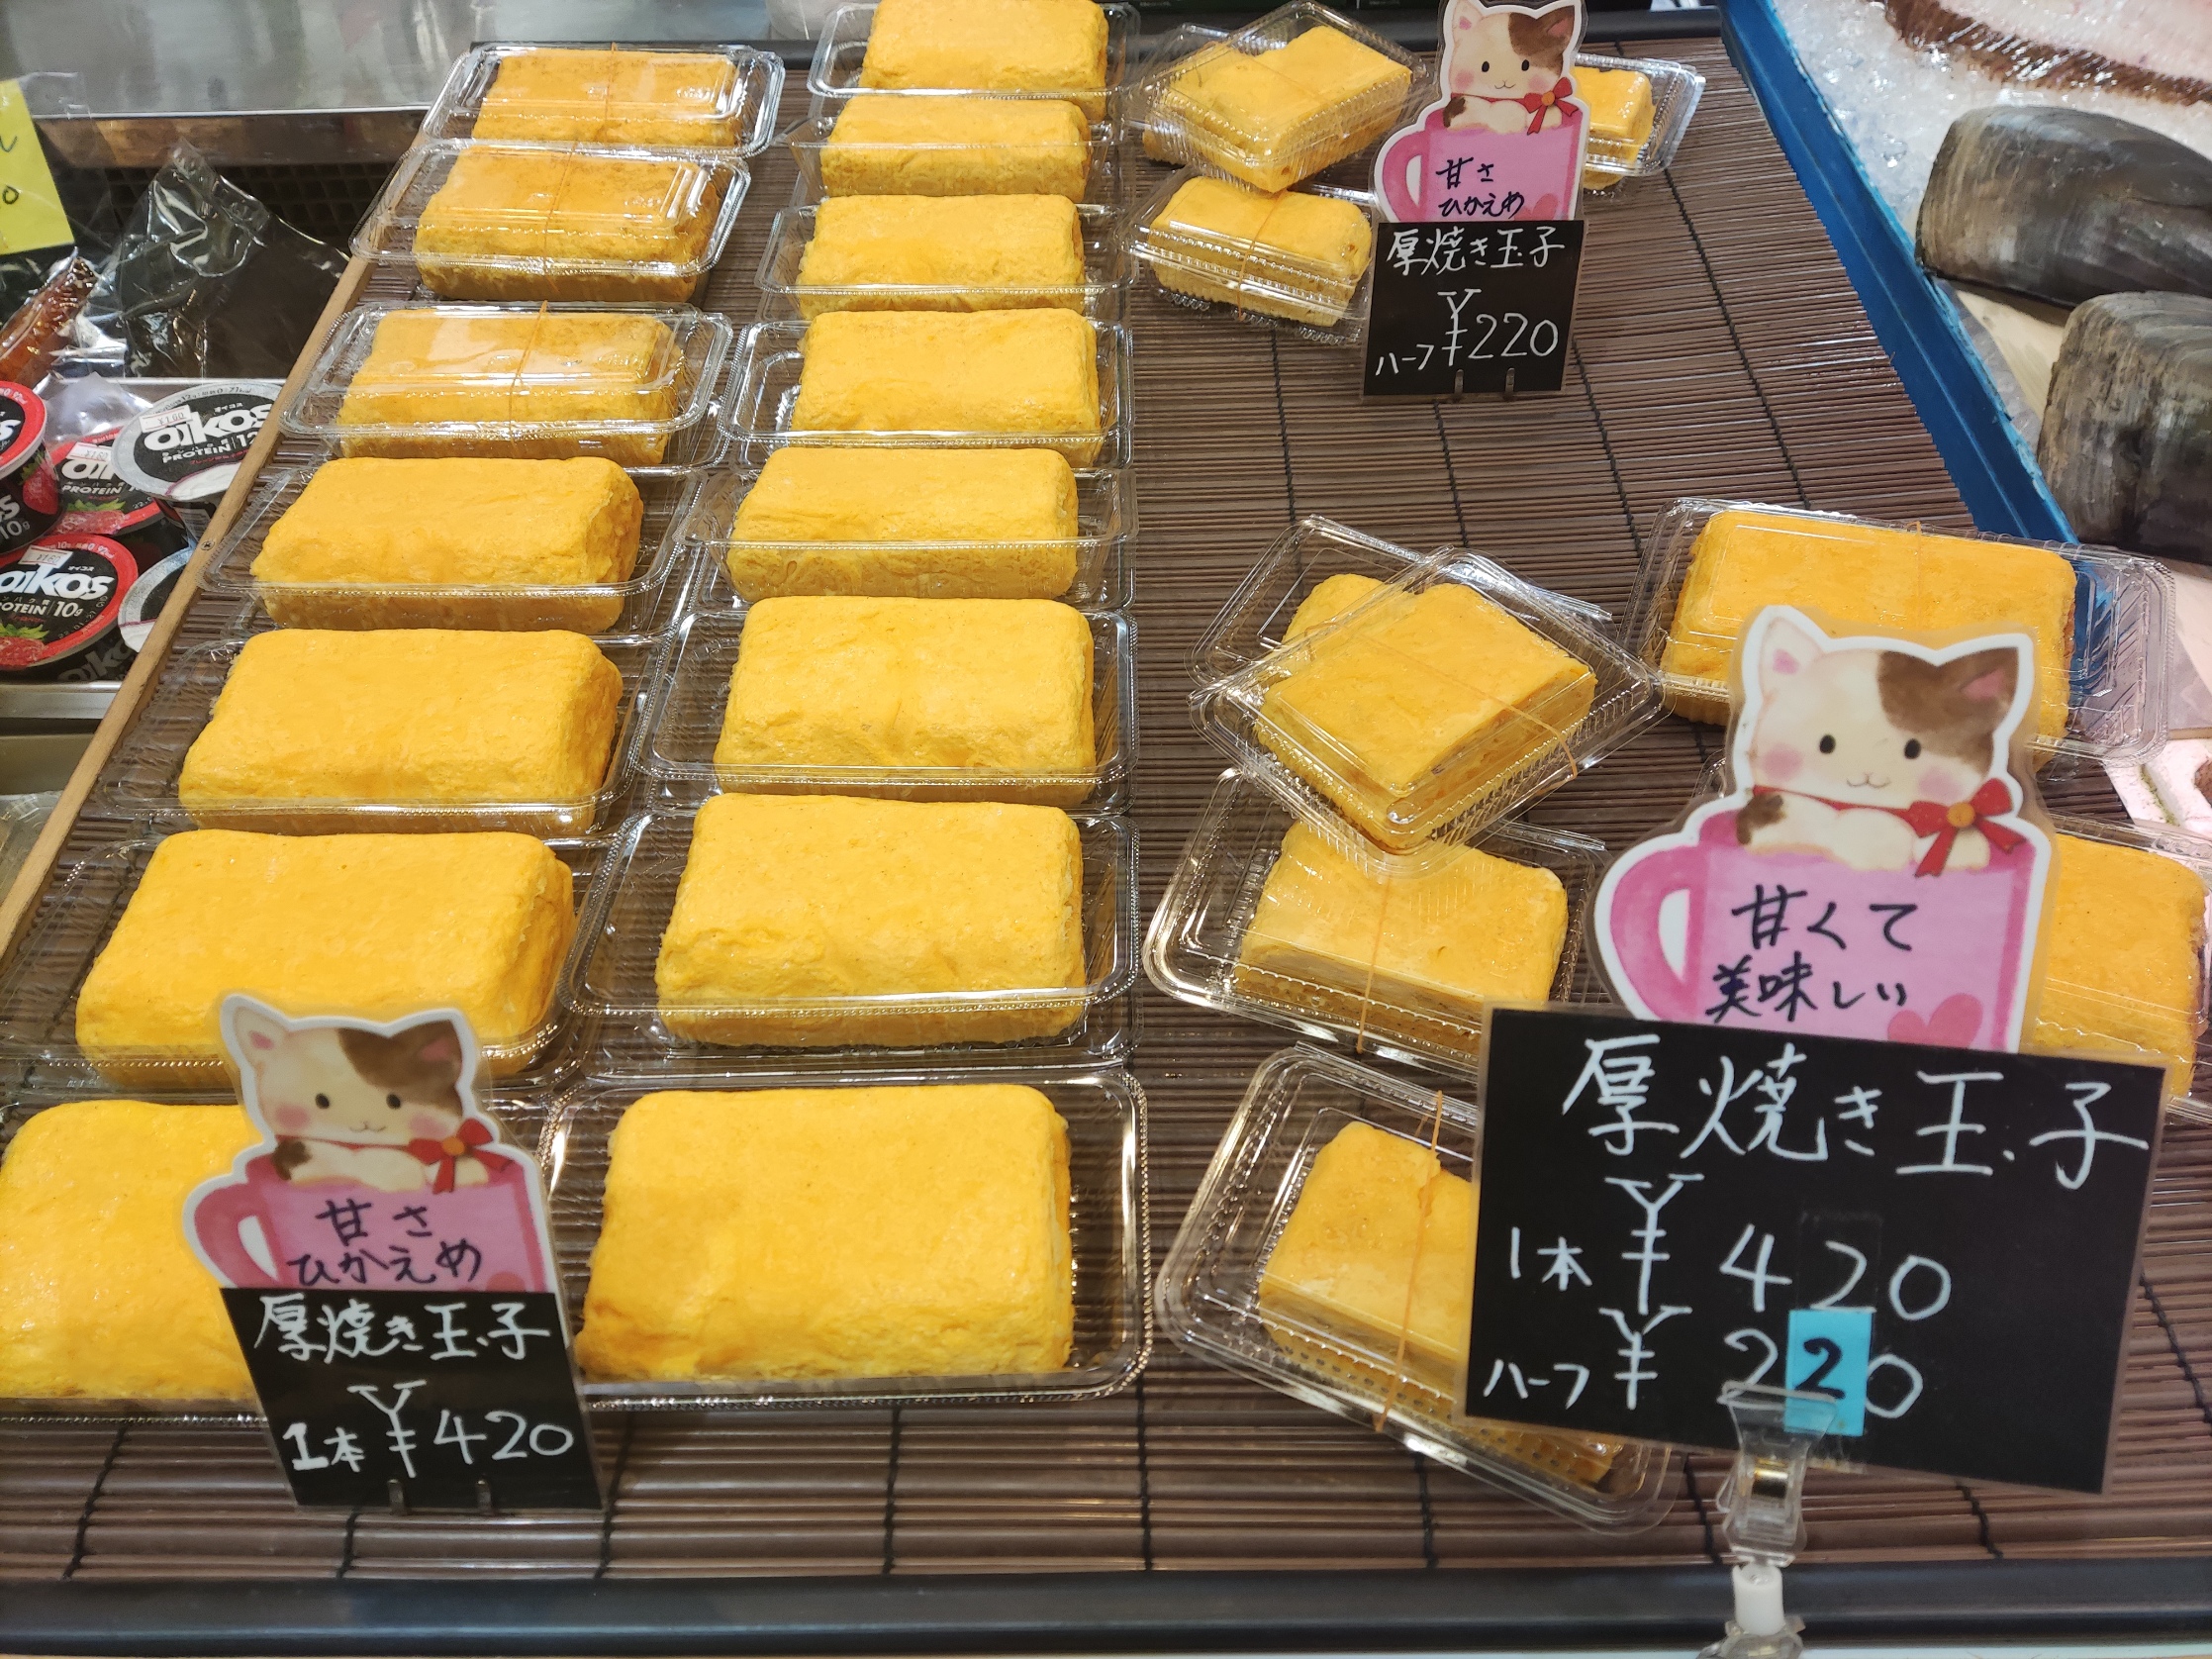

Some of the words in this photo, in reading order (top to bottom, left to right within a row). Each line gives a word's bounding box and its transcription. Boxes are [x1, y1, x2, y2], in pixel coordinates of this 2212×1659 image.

[1435, 156, 1495, 189] 甘さ
[1438, 191, 1524, 220] ひかえめ
[1386, 226, 1565, 275] 厚焼き玉子
[1375, 343, 1434, 376] ハーフ
[161, 443, 232, 463] PROTEIN
[62, 484, 123, 495] PROTEIN
[0, 564, 115, 600] oikos
[53, 601, 84, 618] 10g
[1731, 884, 1919, 952] 甘くて
[1704, 951, 1909, 1024] 美味しい
[1562, 1033, 2150, 1190] 厚焼き玉子
[315, 1198, 433, 1246] 甘さ
[286, 1237, 482, 1287] ひかえめ
[1509, 1226, 1592, 1292] 1本
[253, 1292, 551, 1364] 厚焼き玉子
[1483, 1359, 1590, 1410] ハーフ
[282, 1421, 366, 1473] 1本
